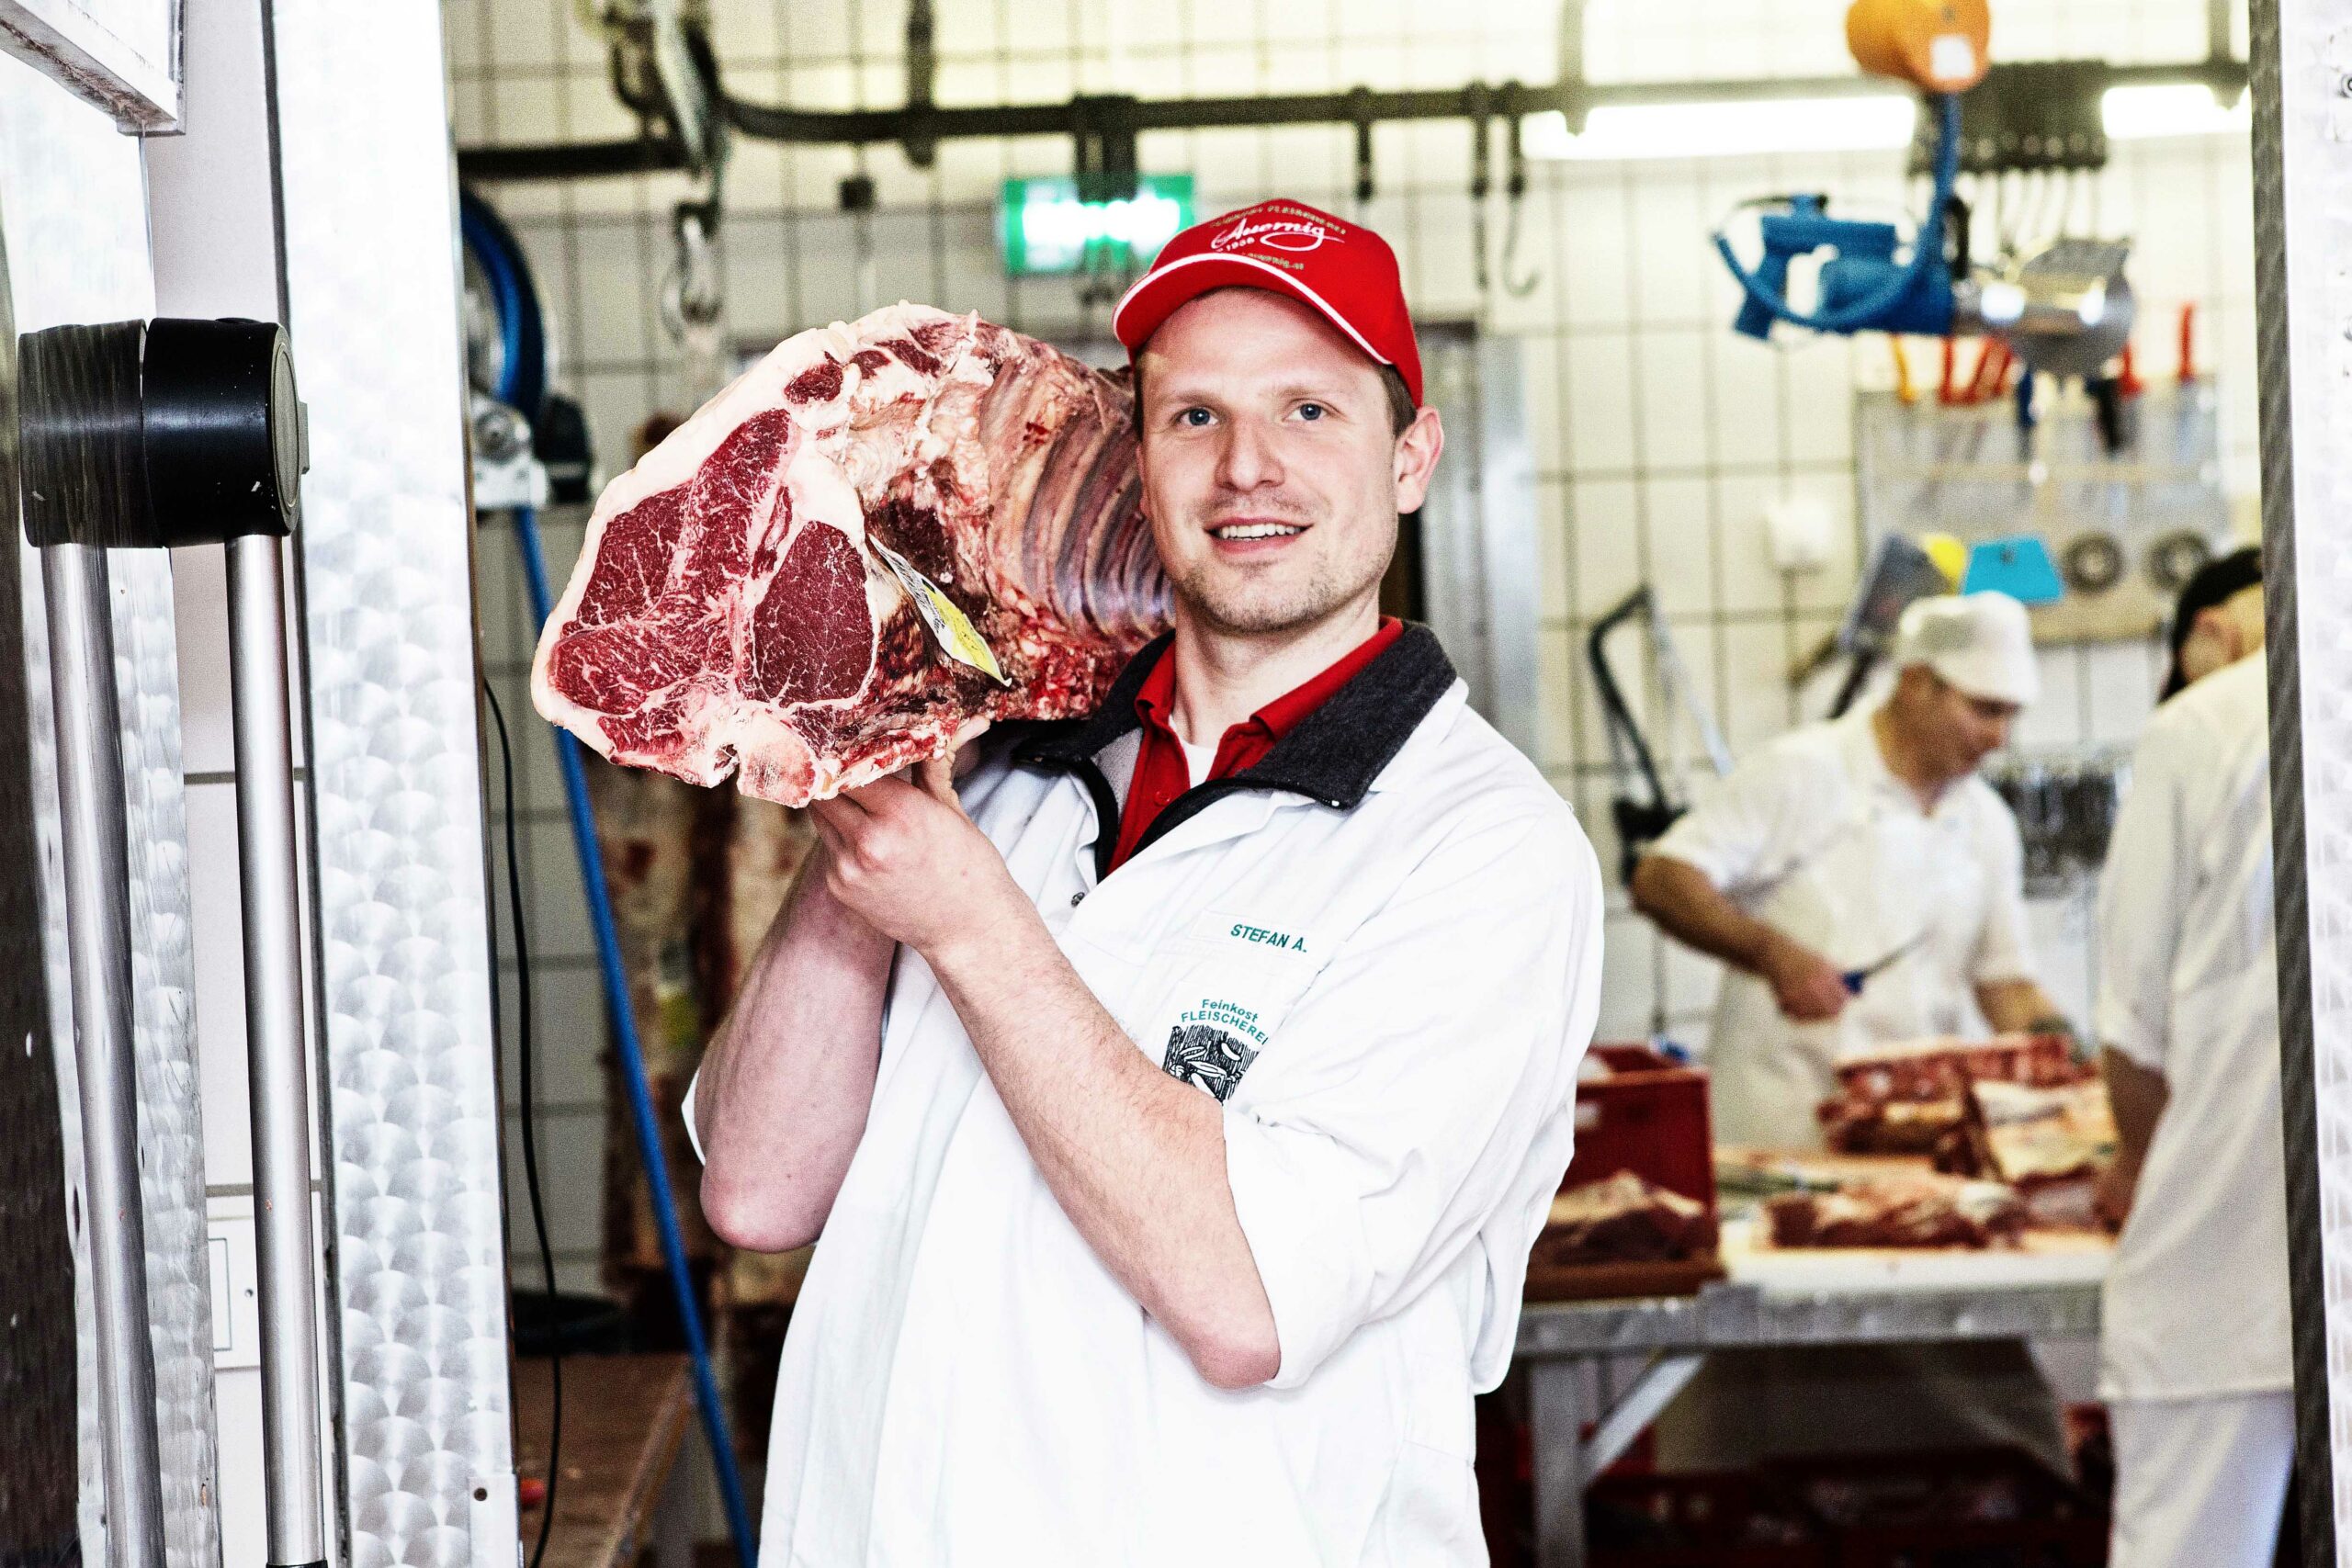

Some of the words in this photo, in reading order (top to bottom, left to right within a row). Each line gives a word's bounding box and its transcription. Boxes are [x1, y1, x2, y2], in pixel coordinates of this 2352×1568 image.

[1230, 923, 1290, 948] STEFAN
[1292, 937, 1307, 953] A.
[1202, 998, 1259, 1022] Feinkost
[1182, 1010, 1269, 1045] FLEISCHEREI
